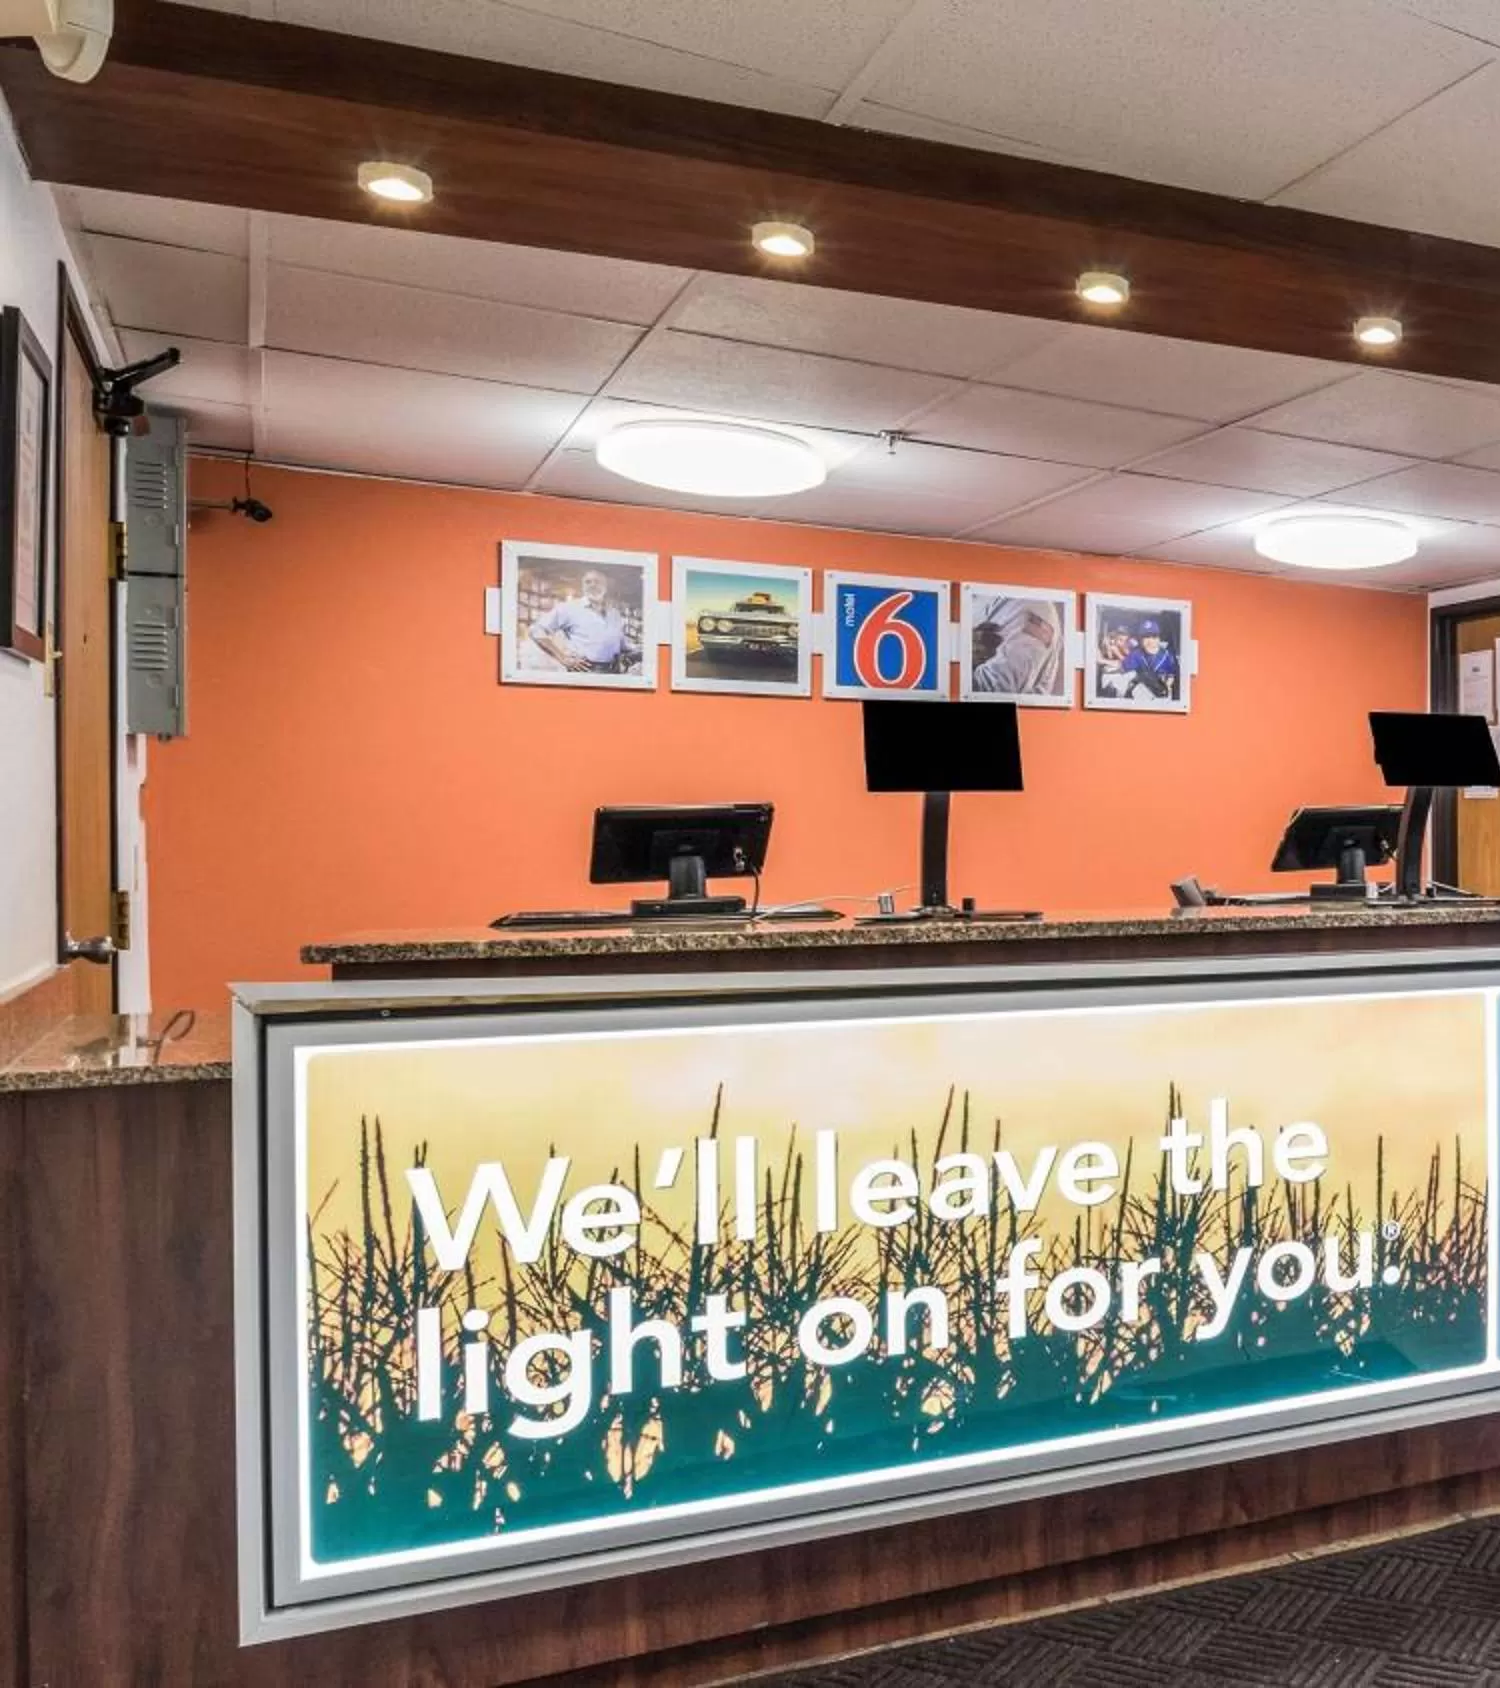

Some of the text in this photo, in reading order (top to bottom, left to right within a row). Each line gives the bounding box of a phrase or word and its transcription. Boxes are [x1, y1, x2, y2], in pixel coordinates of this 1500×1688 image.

[843, 591, 927, 690] motel 6
[404, 1096, 1329, 1272] We'll leave the
[416, 1286, 748, 1440] light
[798, 1284, 950, 1367] on
[997, 1236, 1161, 1339] for
